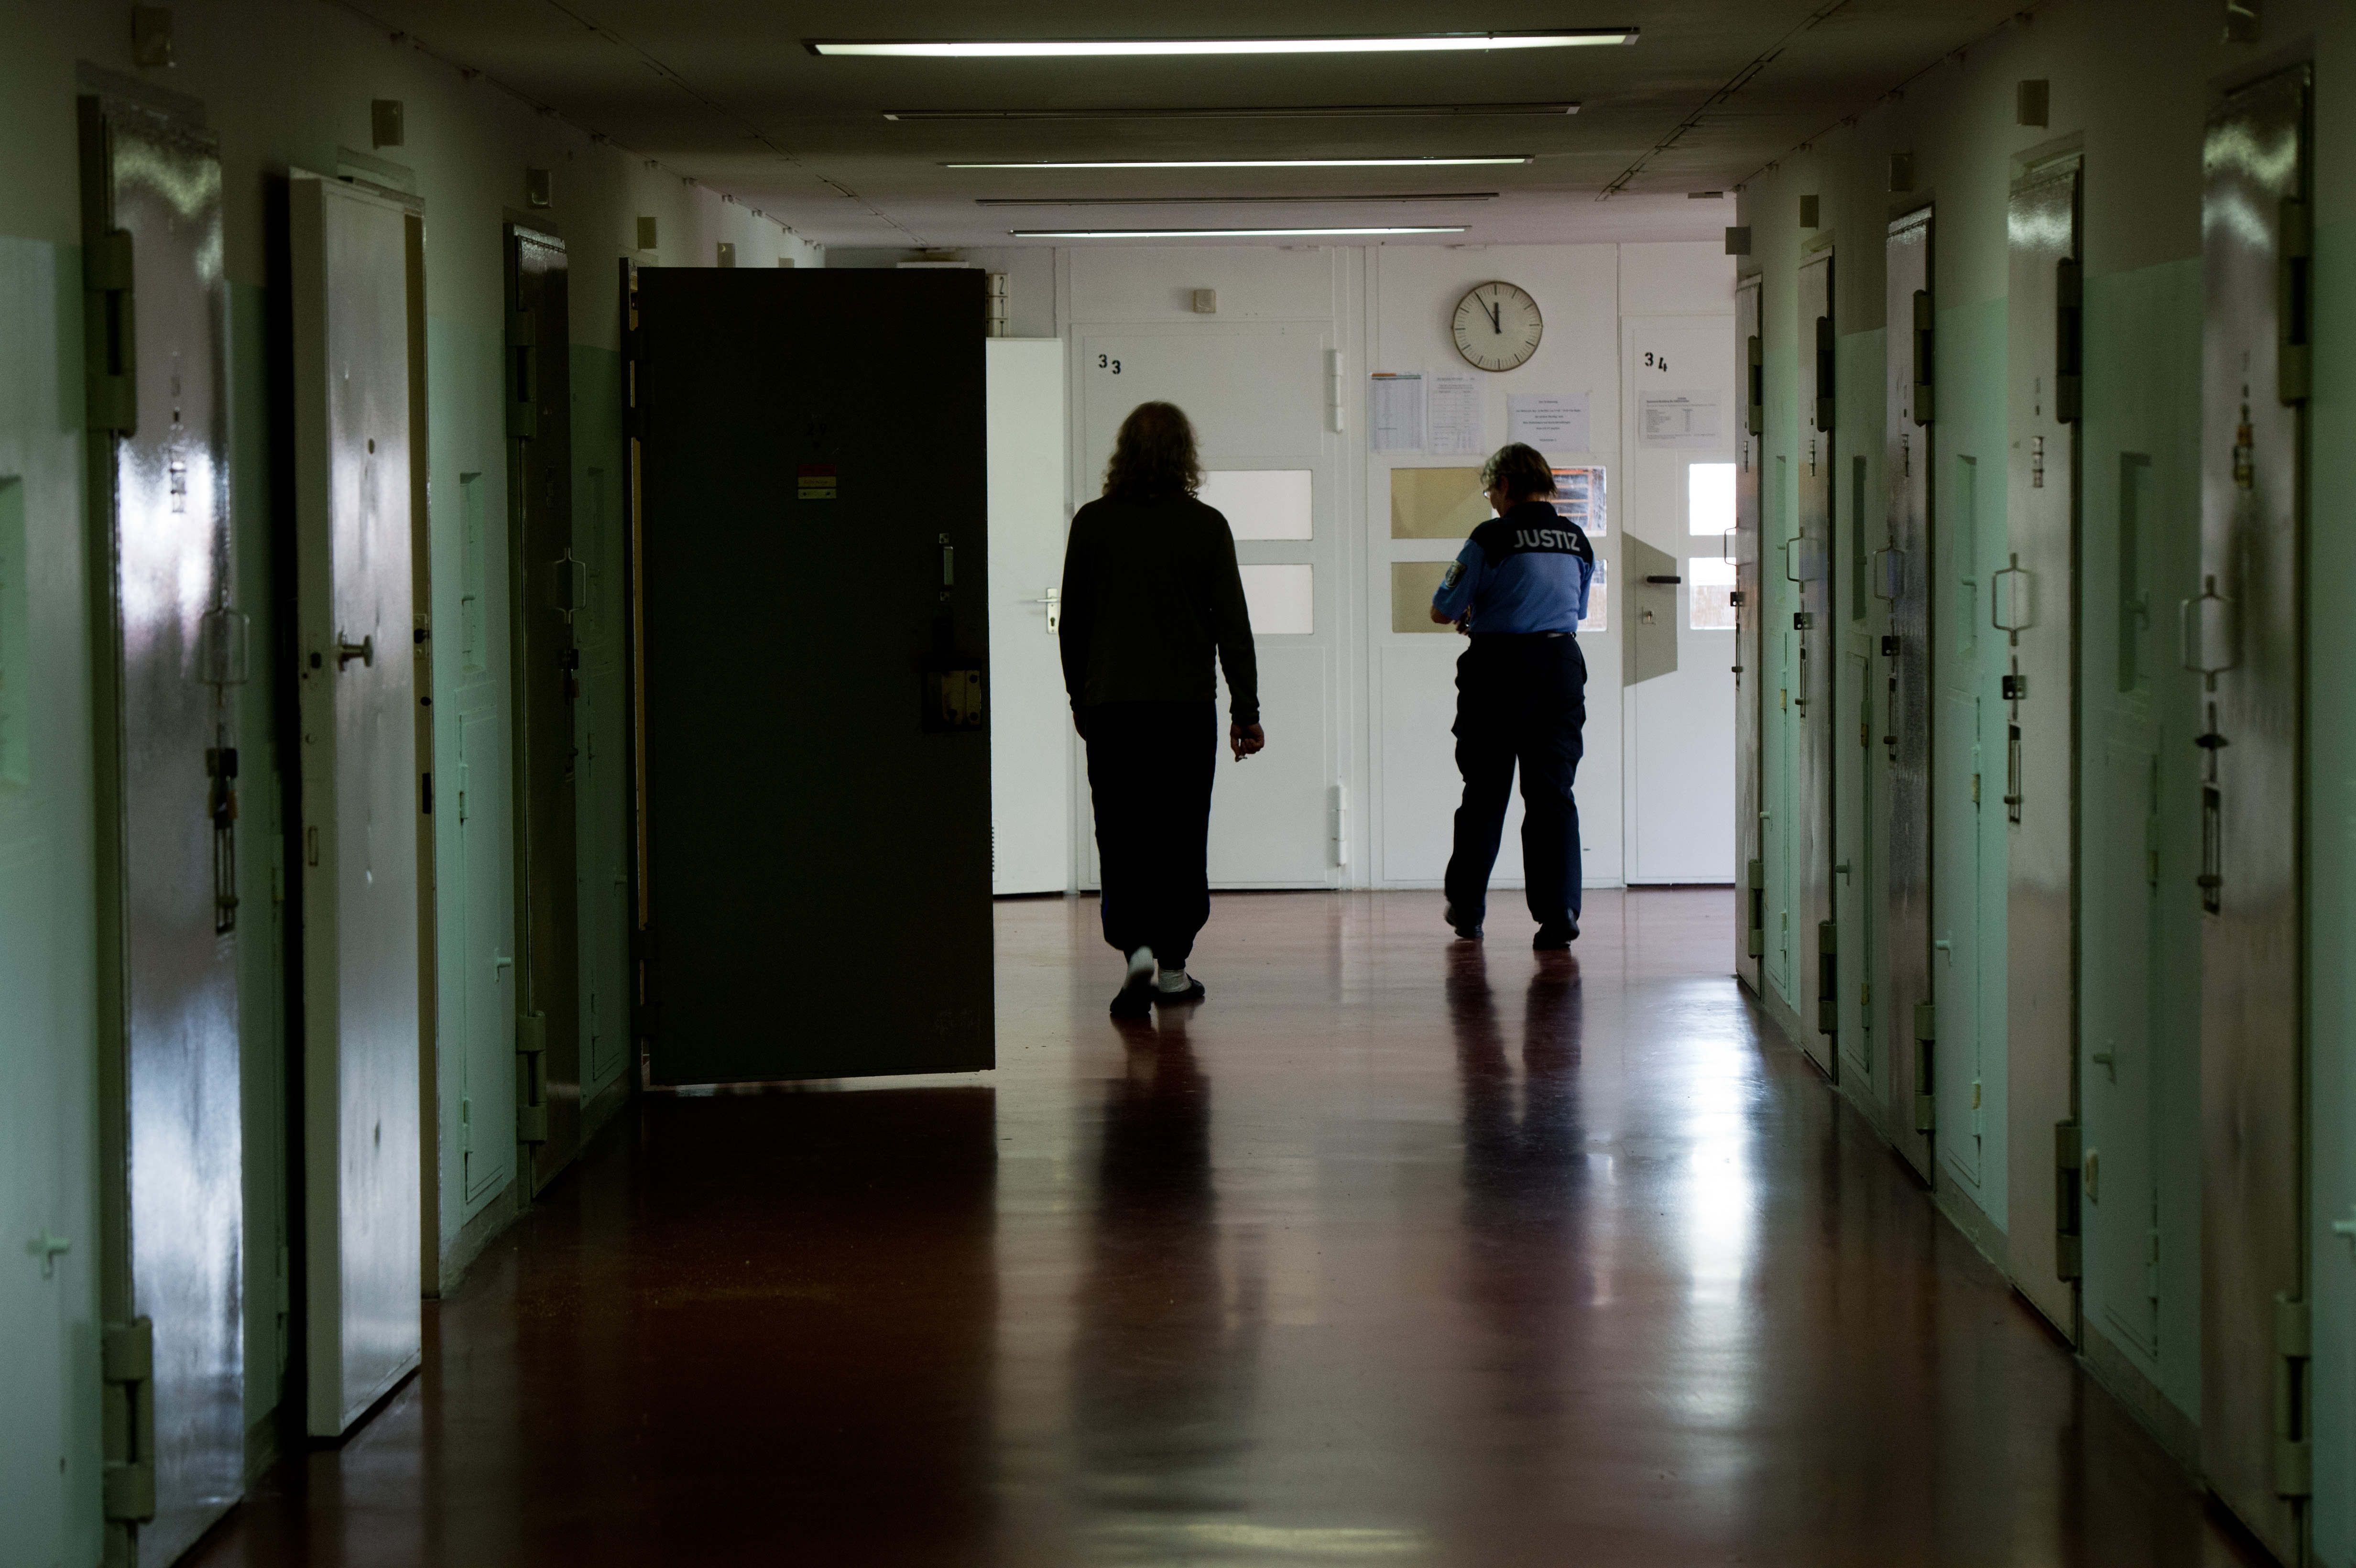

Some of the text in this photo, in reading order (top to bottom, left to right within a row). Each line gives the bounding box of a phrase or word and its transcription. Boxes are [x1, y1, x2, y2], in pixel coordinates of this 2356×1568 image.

[1099, 354, 1121, 374] 33
[1645, 352, 1668, 372] 34
[1513, 529, 1581, 552] JUSTIZ
